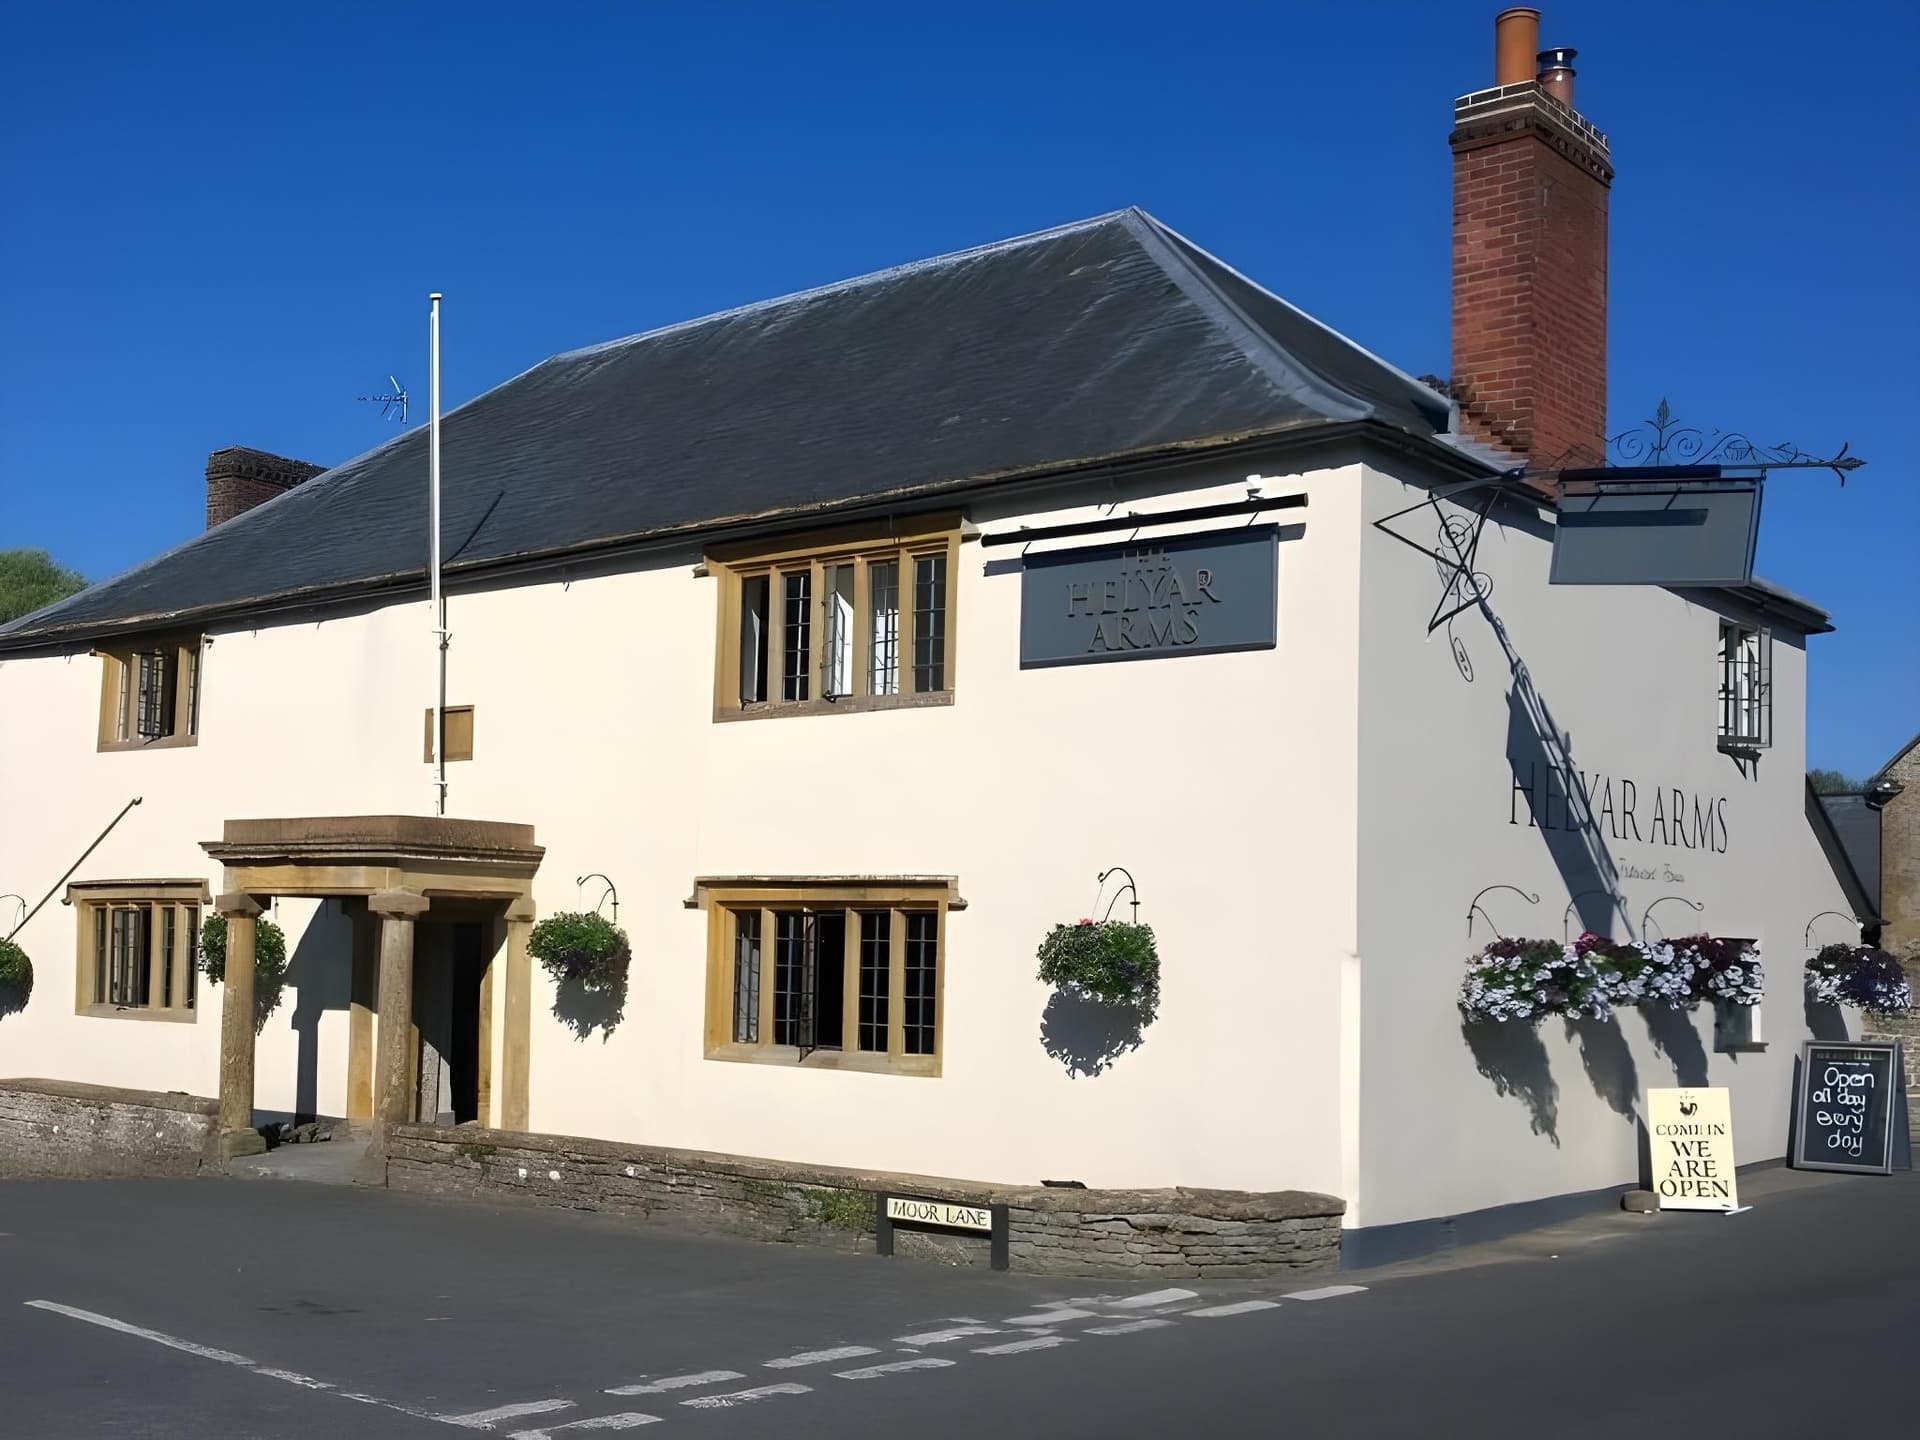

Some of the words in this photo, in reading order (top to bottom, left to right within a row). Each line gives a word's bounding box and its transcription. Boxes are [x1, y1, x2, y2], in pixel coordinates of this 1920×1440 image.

[1065, 568, 1223, 618] HELYAR
[1087, 608, 1201, 653] ARMS
[1650, 785, 1729, 854] ARMS
[1824, 1066, 1875, 1093] Open
[1837, 1087, 1866, 1114] day
[1707, 1123, 1725, 1136] IN
[1827, 1128, 1863, 1157] day
[1669, 1140, 1712, 1158] WE
[1668, 1160, 1718, 1178] ARE
[1660, 1179, 1729, 1198] OPEN
[892, 1201, 940, 1222] MOOR
[945, 1206, 988, 1227] LANE
